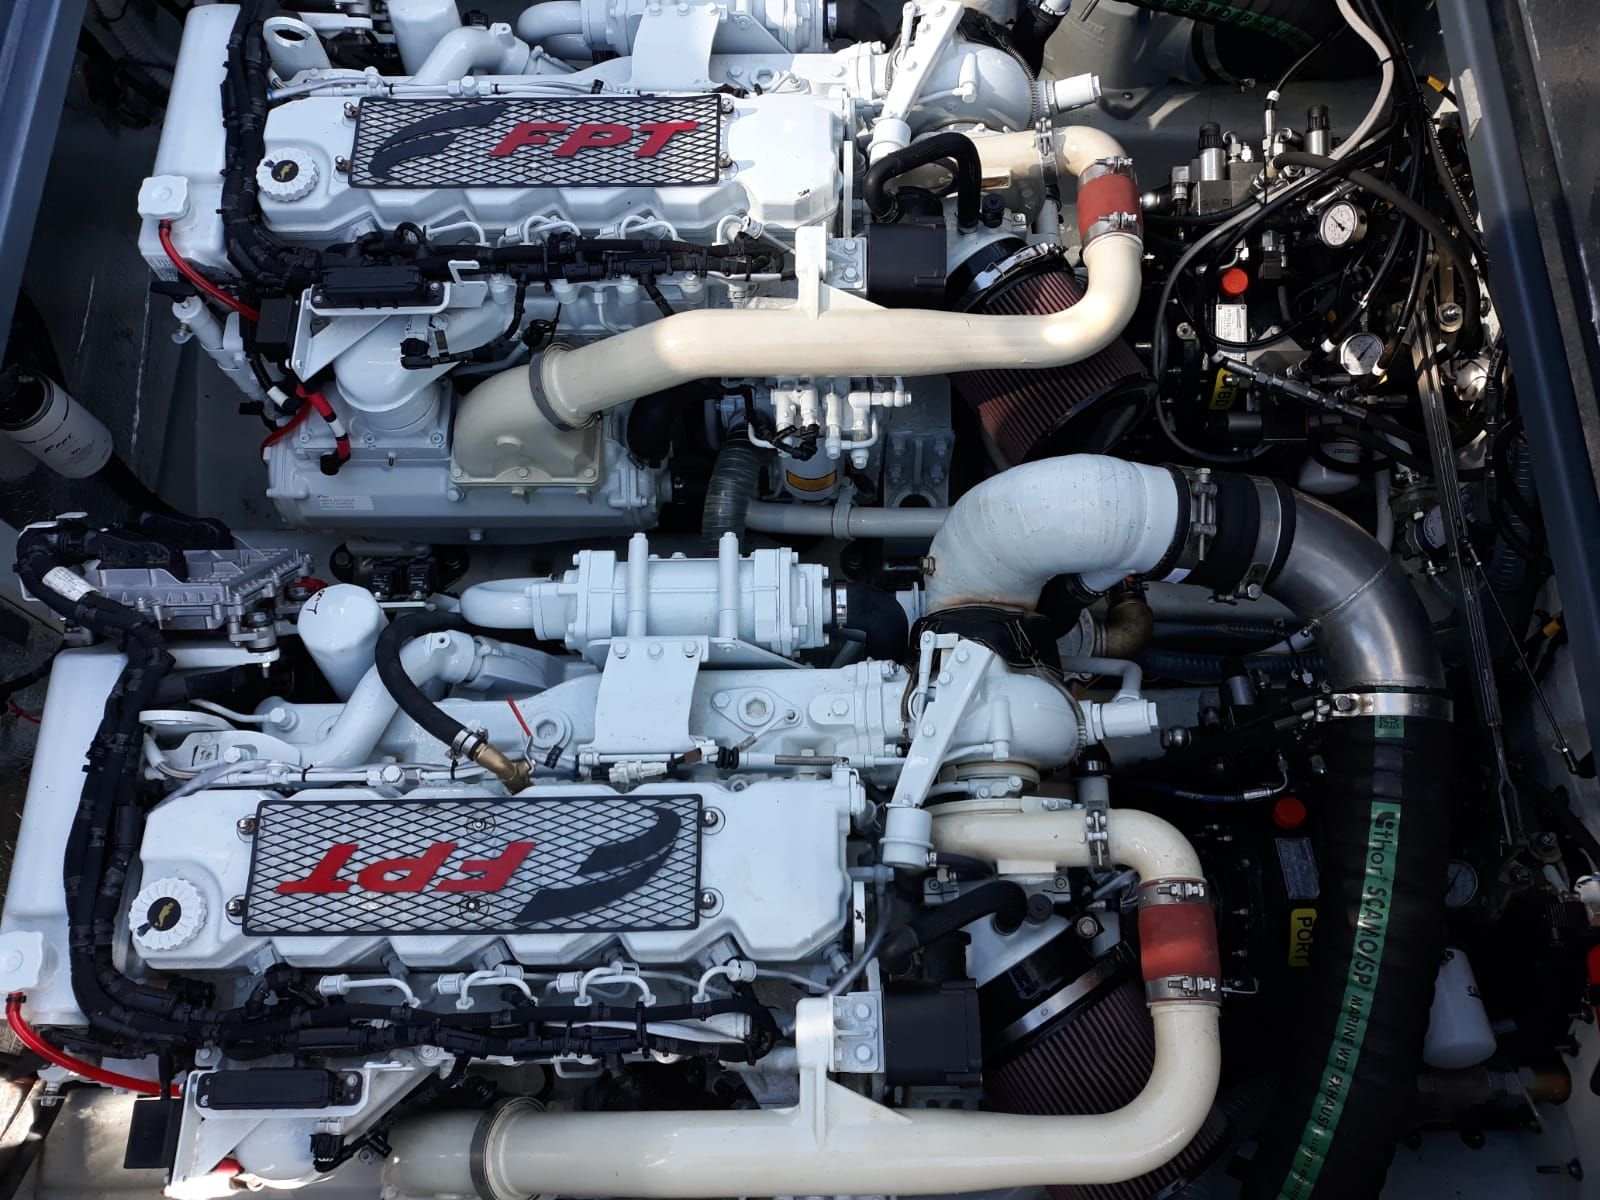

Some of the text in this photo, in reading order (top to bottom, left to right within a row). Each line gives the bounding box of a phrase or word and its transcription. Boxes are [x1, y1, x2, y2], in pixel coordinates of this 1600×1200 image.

[488, 120, 697, 157] FPT
[273, 841, 537, 893] FPT
[1353, 885, 1388, 985] SCAMO/SP
[1342, 994, 1363, 1047] MARINE
[1335, 1047, 1352, 1073] WET
[1317, 1074, 1343, 1130] EXHAUST
